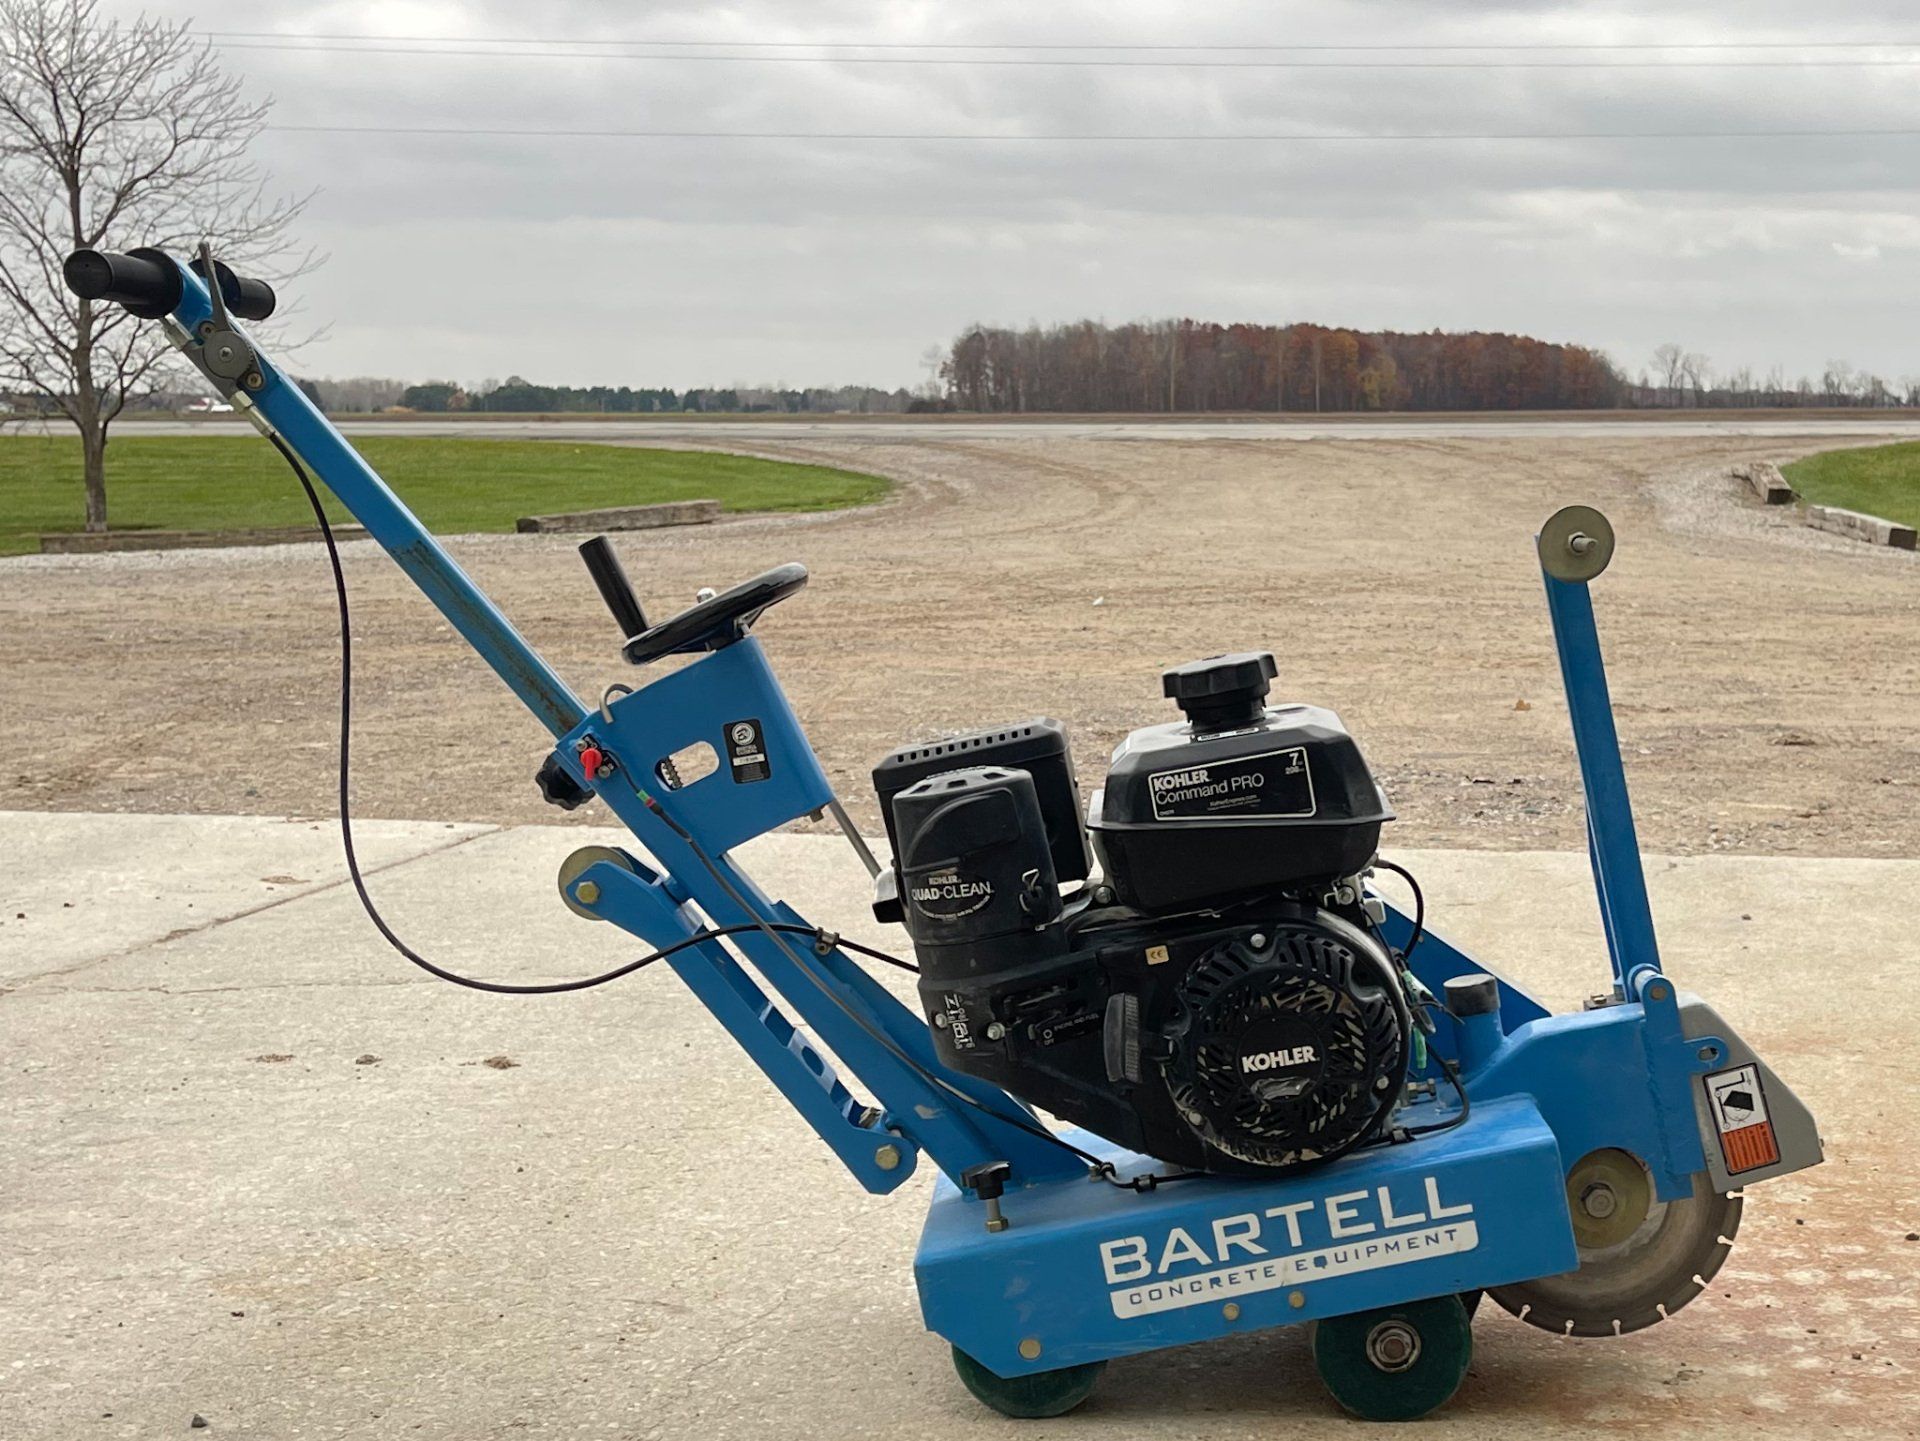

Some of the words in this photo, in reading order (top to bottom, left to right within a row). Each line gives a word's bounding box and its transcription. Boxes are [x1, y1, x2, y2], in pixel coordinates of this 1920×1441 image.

[1153, 769, 1210, 792] KOHLER
[1155, 779, 1229, 805] Command
[1231, 772, 1265, 791] PRO
[911, 881, 991, 901] QUAD-CLEAN
[928, 875, 959, 885] KOHLER
[1241, 1045, 1316, 1074] KOHLER
[1100, 1176, 1474, 1285] BARTELL
[1129, 1264, 1277, 1306] CONCRETE
[1295, 1228, 1458, 1272] EQUIPMENT
